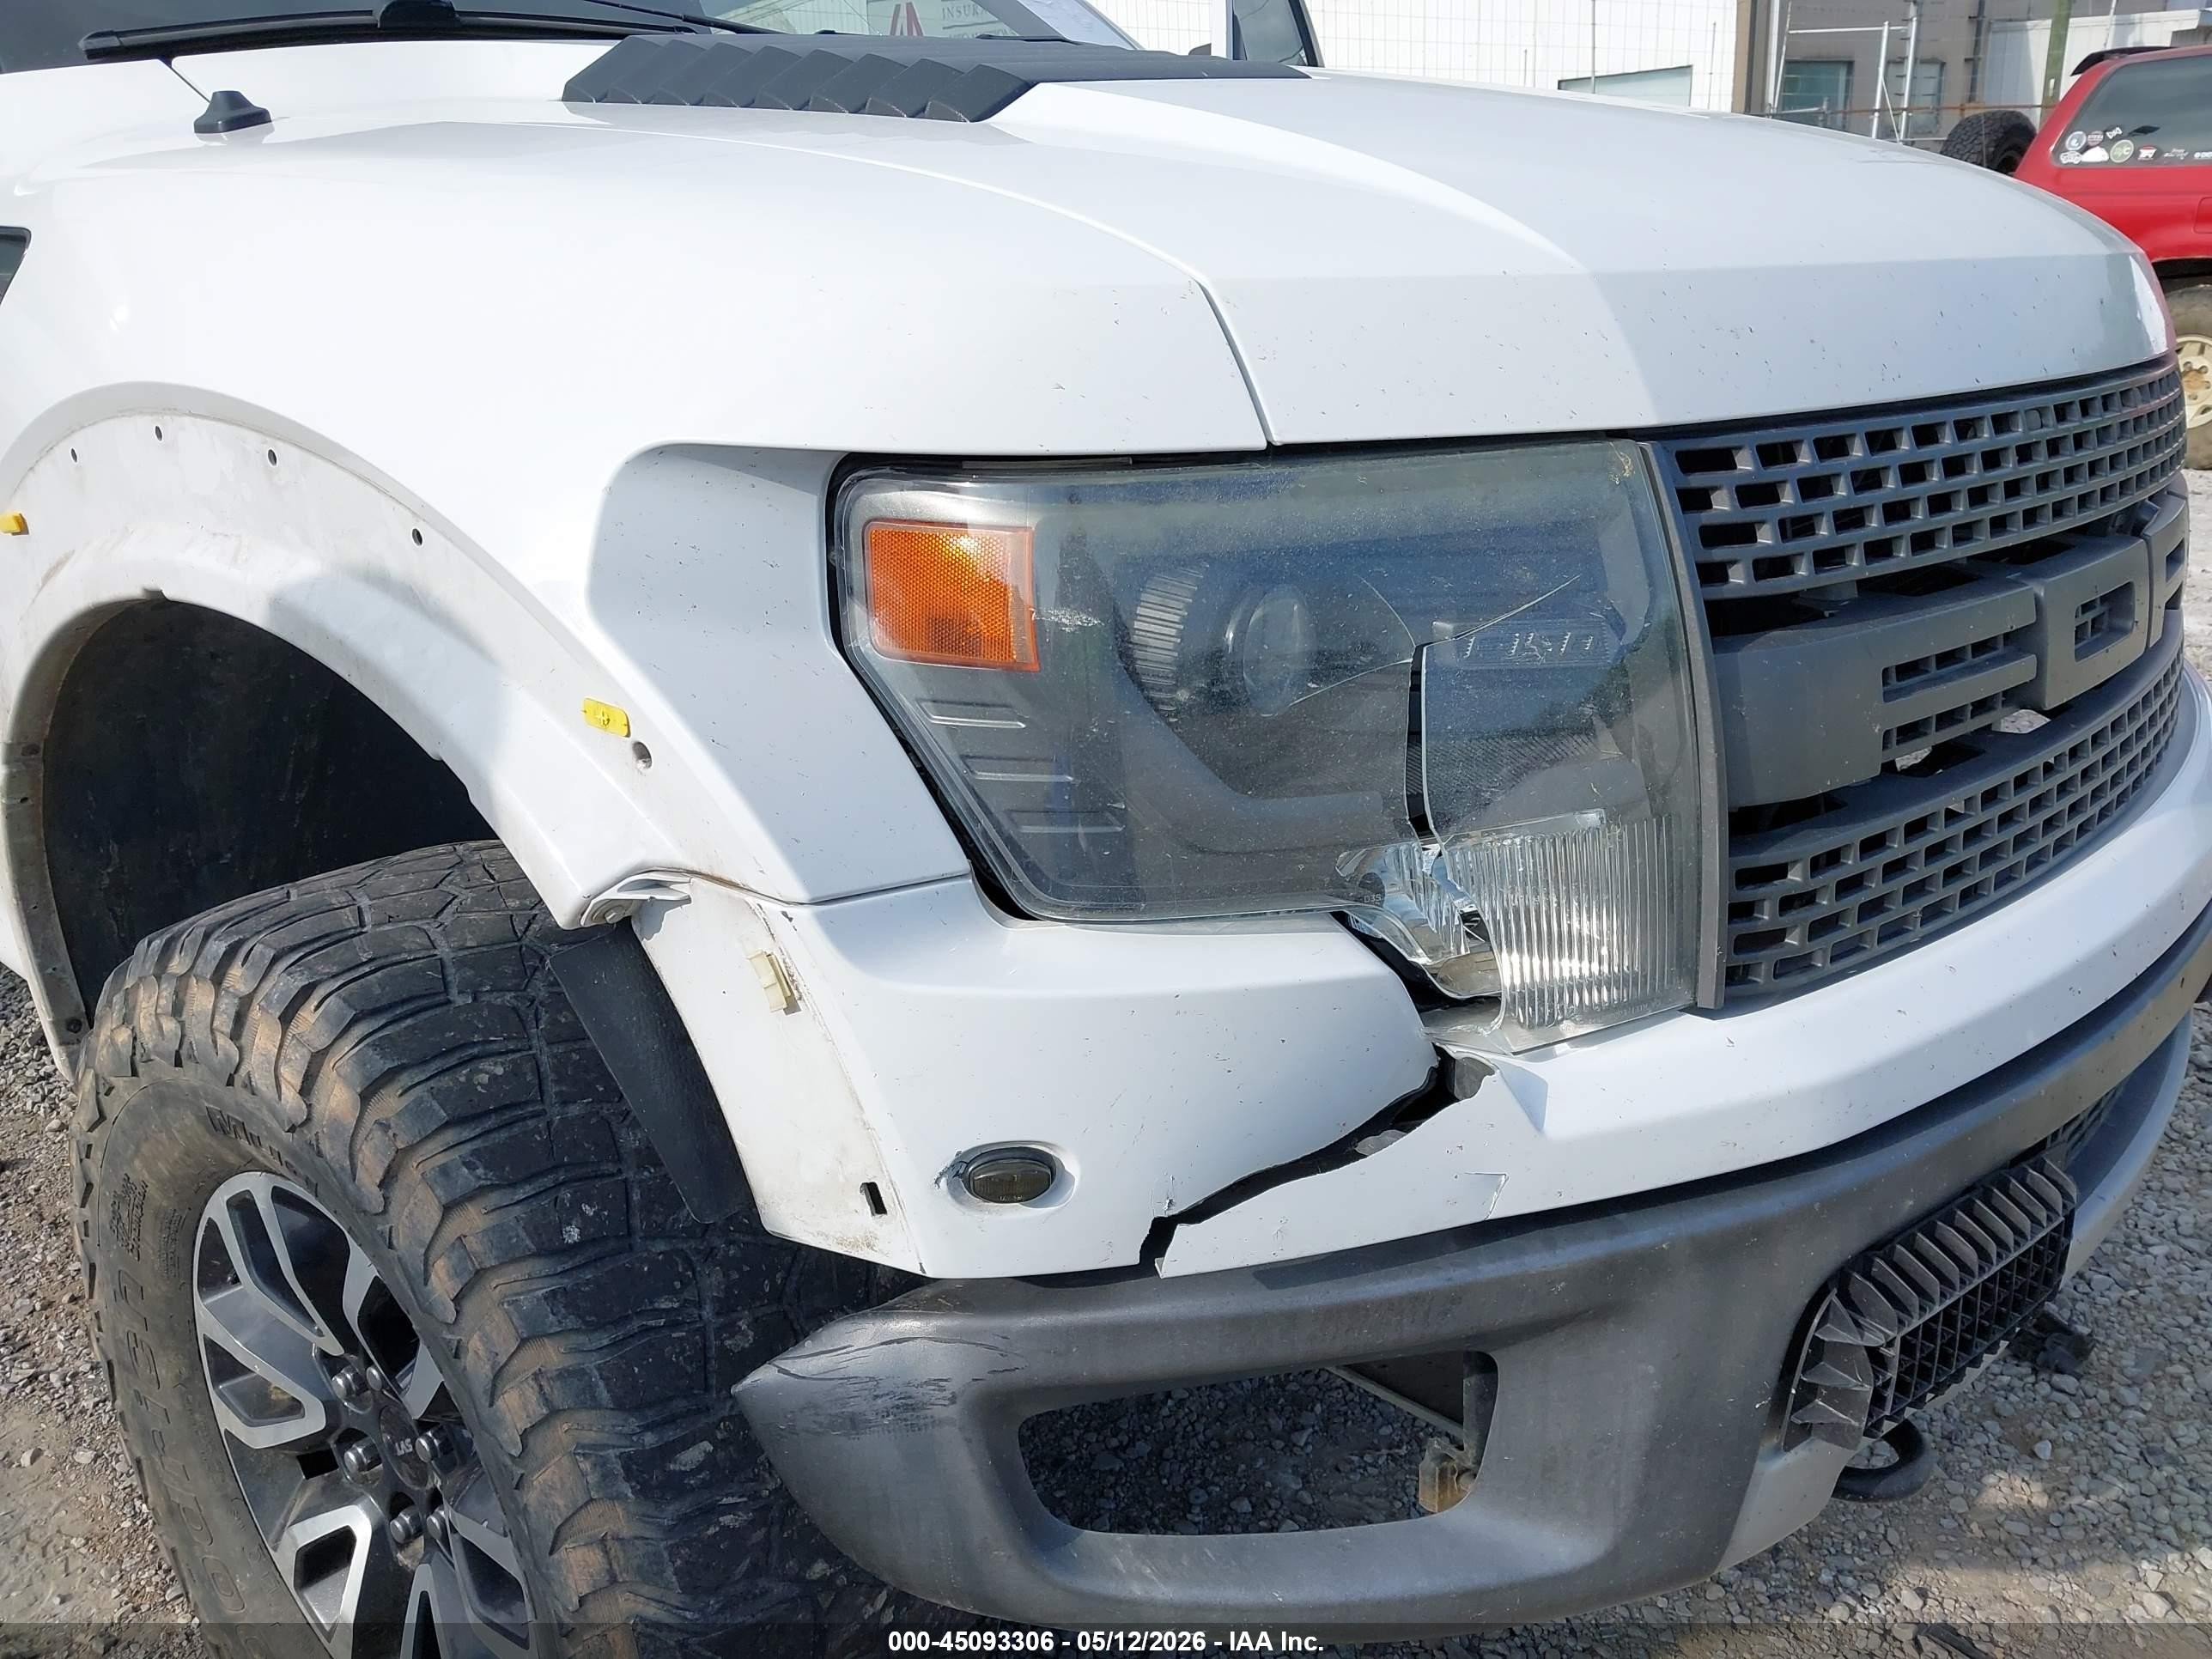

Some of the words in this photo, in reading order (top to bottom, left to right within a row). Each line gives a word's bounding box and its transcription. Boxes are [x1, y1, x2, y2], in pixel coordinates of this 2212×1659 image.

[1713, 492, 2189, 807] FOR
[1364, 893, 1382, 903] D3S
[395, 1437, 413, 1456] SVT
